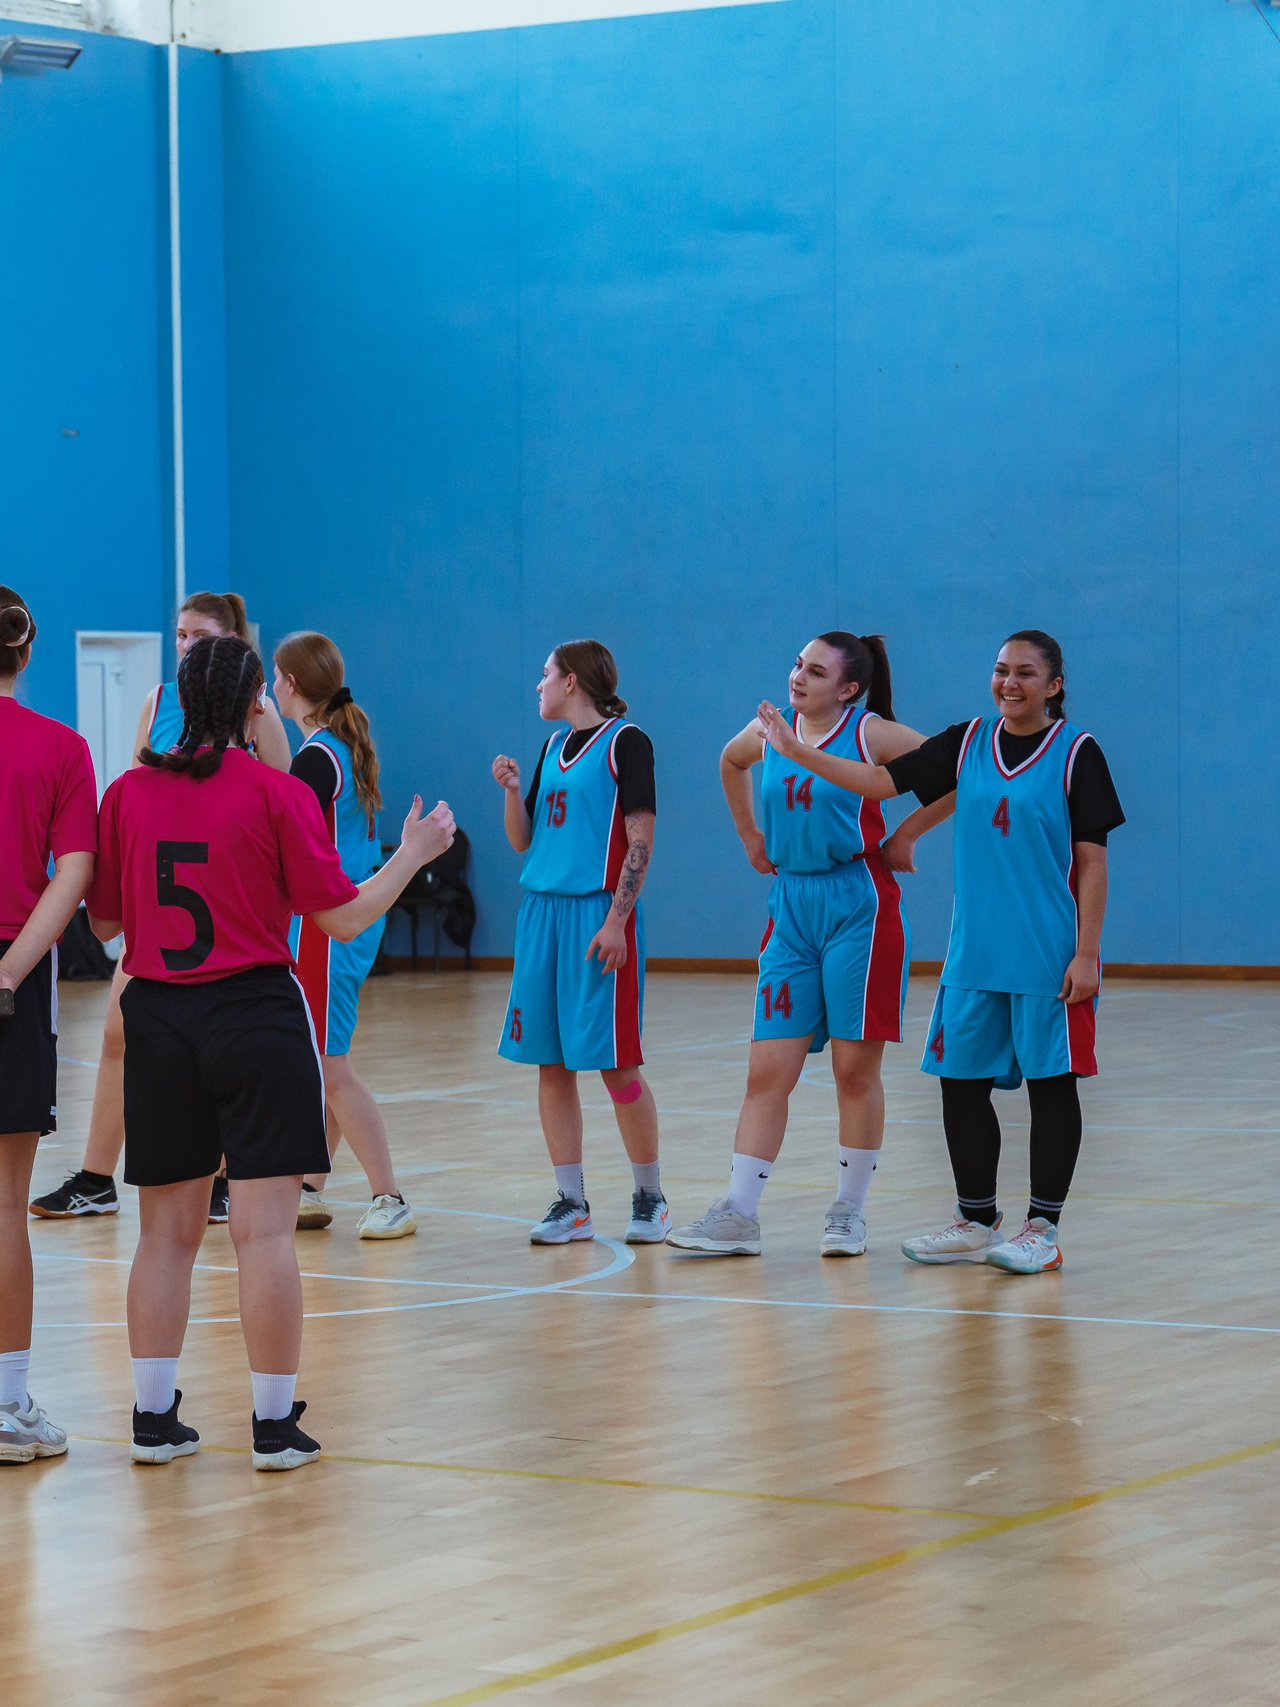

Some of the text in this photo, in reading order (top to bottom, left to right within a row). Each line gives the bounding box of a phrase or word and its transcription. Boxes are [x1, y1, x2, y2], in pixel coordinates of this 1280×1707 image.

[546, 789, 567, 828] 15
[782, 774, 814, 812] 14
[992, 795, 1011, 836] 4
[156, 840, 215, 971] 5
[761, 981, 793, 1020] 14
[929, 1023, 944, 1063] 4
